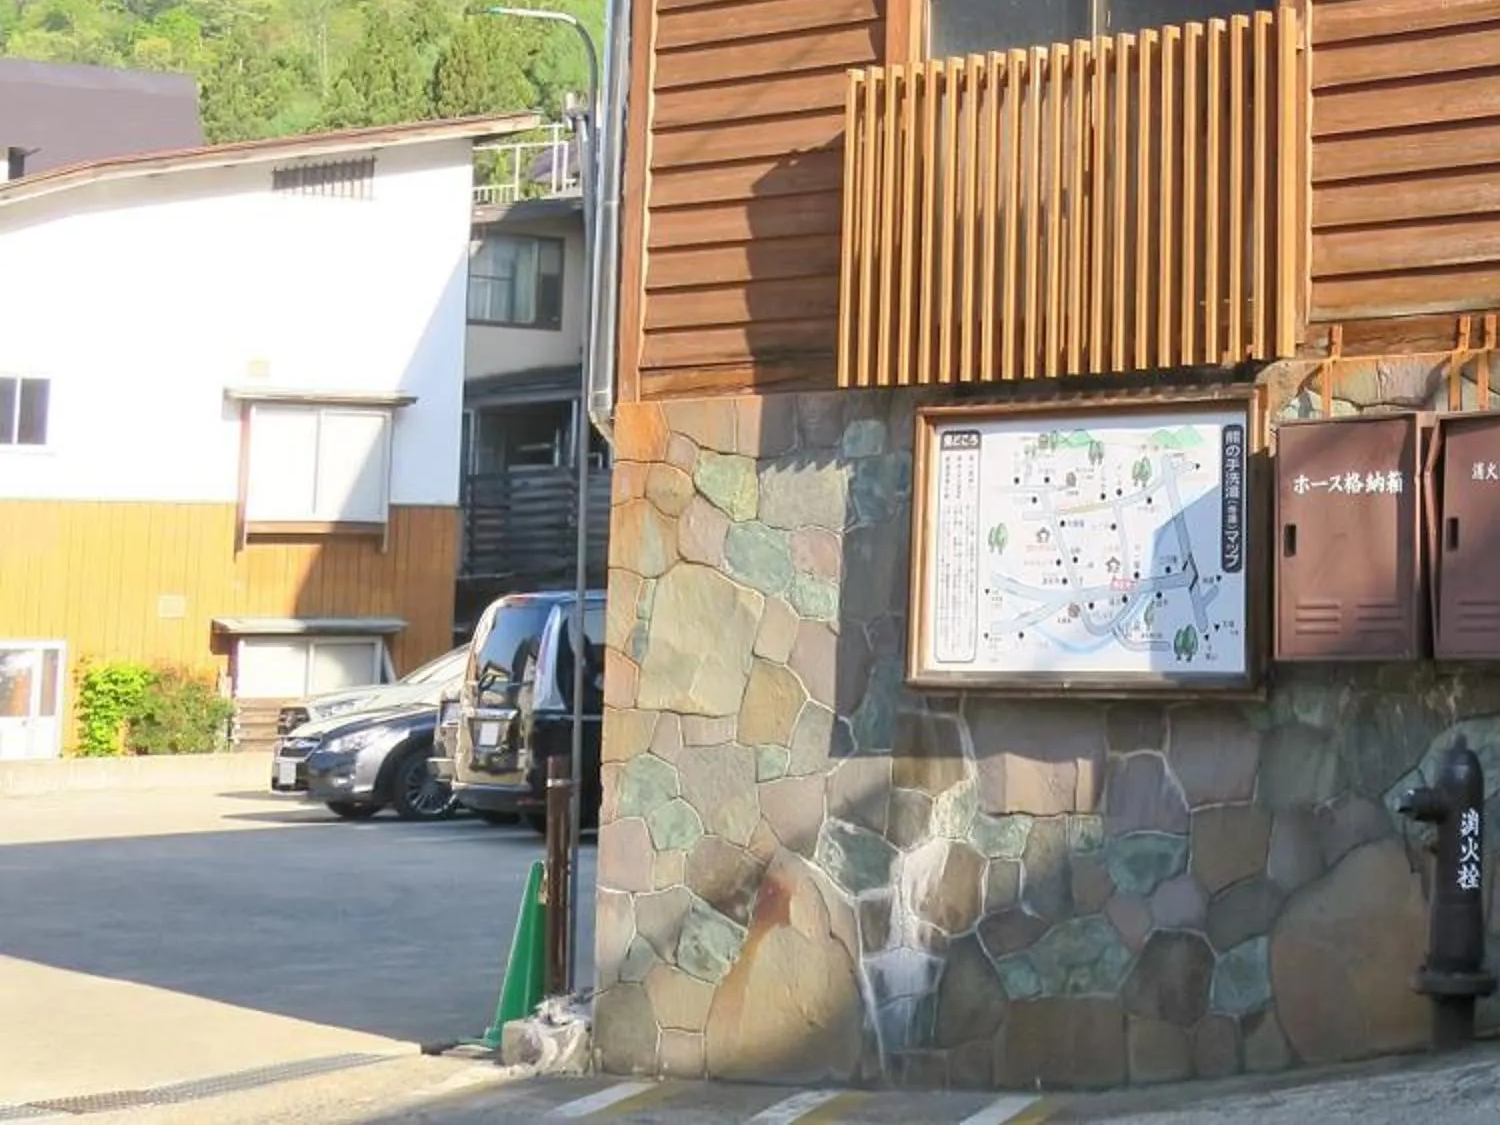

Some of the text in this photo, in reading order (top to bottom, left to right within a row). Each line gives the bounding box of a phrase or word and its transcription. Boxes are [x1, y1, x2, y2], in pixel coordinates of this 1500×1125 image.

[1293, 471, 1403, 494] ホース格納箱
[1456, 807, 1481, 890] 消火栓
